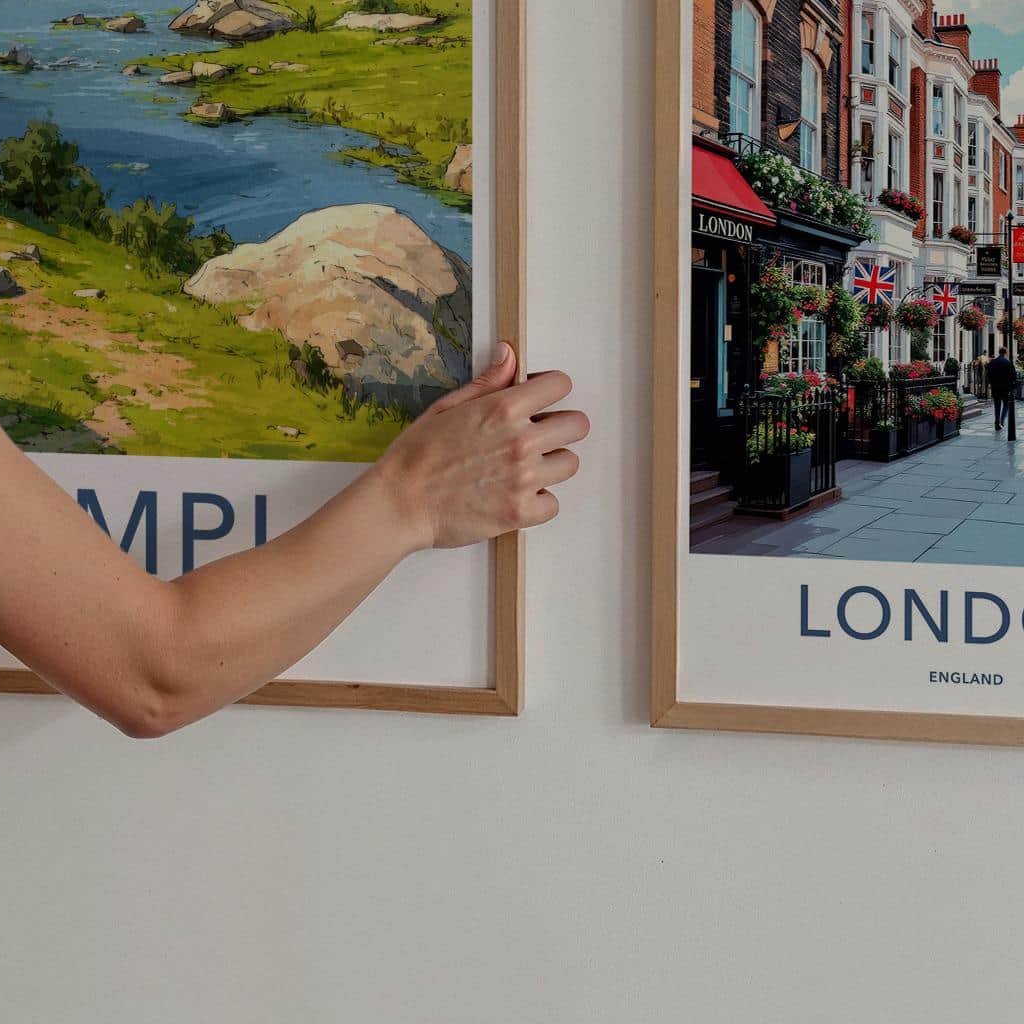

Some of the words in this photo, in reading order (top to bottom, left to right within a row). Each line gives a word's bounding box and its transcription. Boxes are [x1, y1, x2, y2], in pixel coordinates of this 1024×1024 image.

[699, 213, 753, 242] LONDON
[800, 583, 1024, 645] LOND
[929, 671, 1004, 686] ENGLAND
